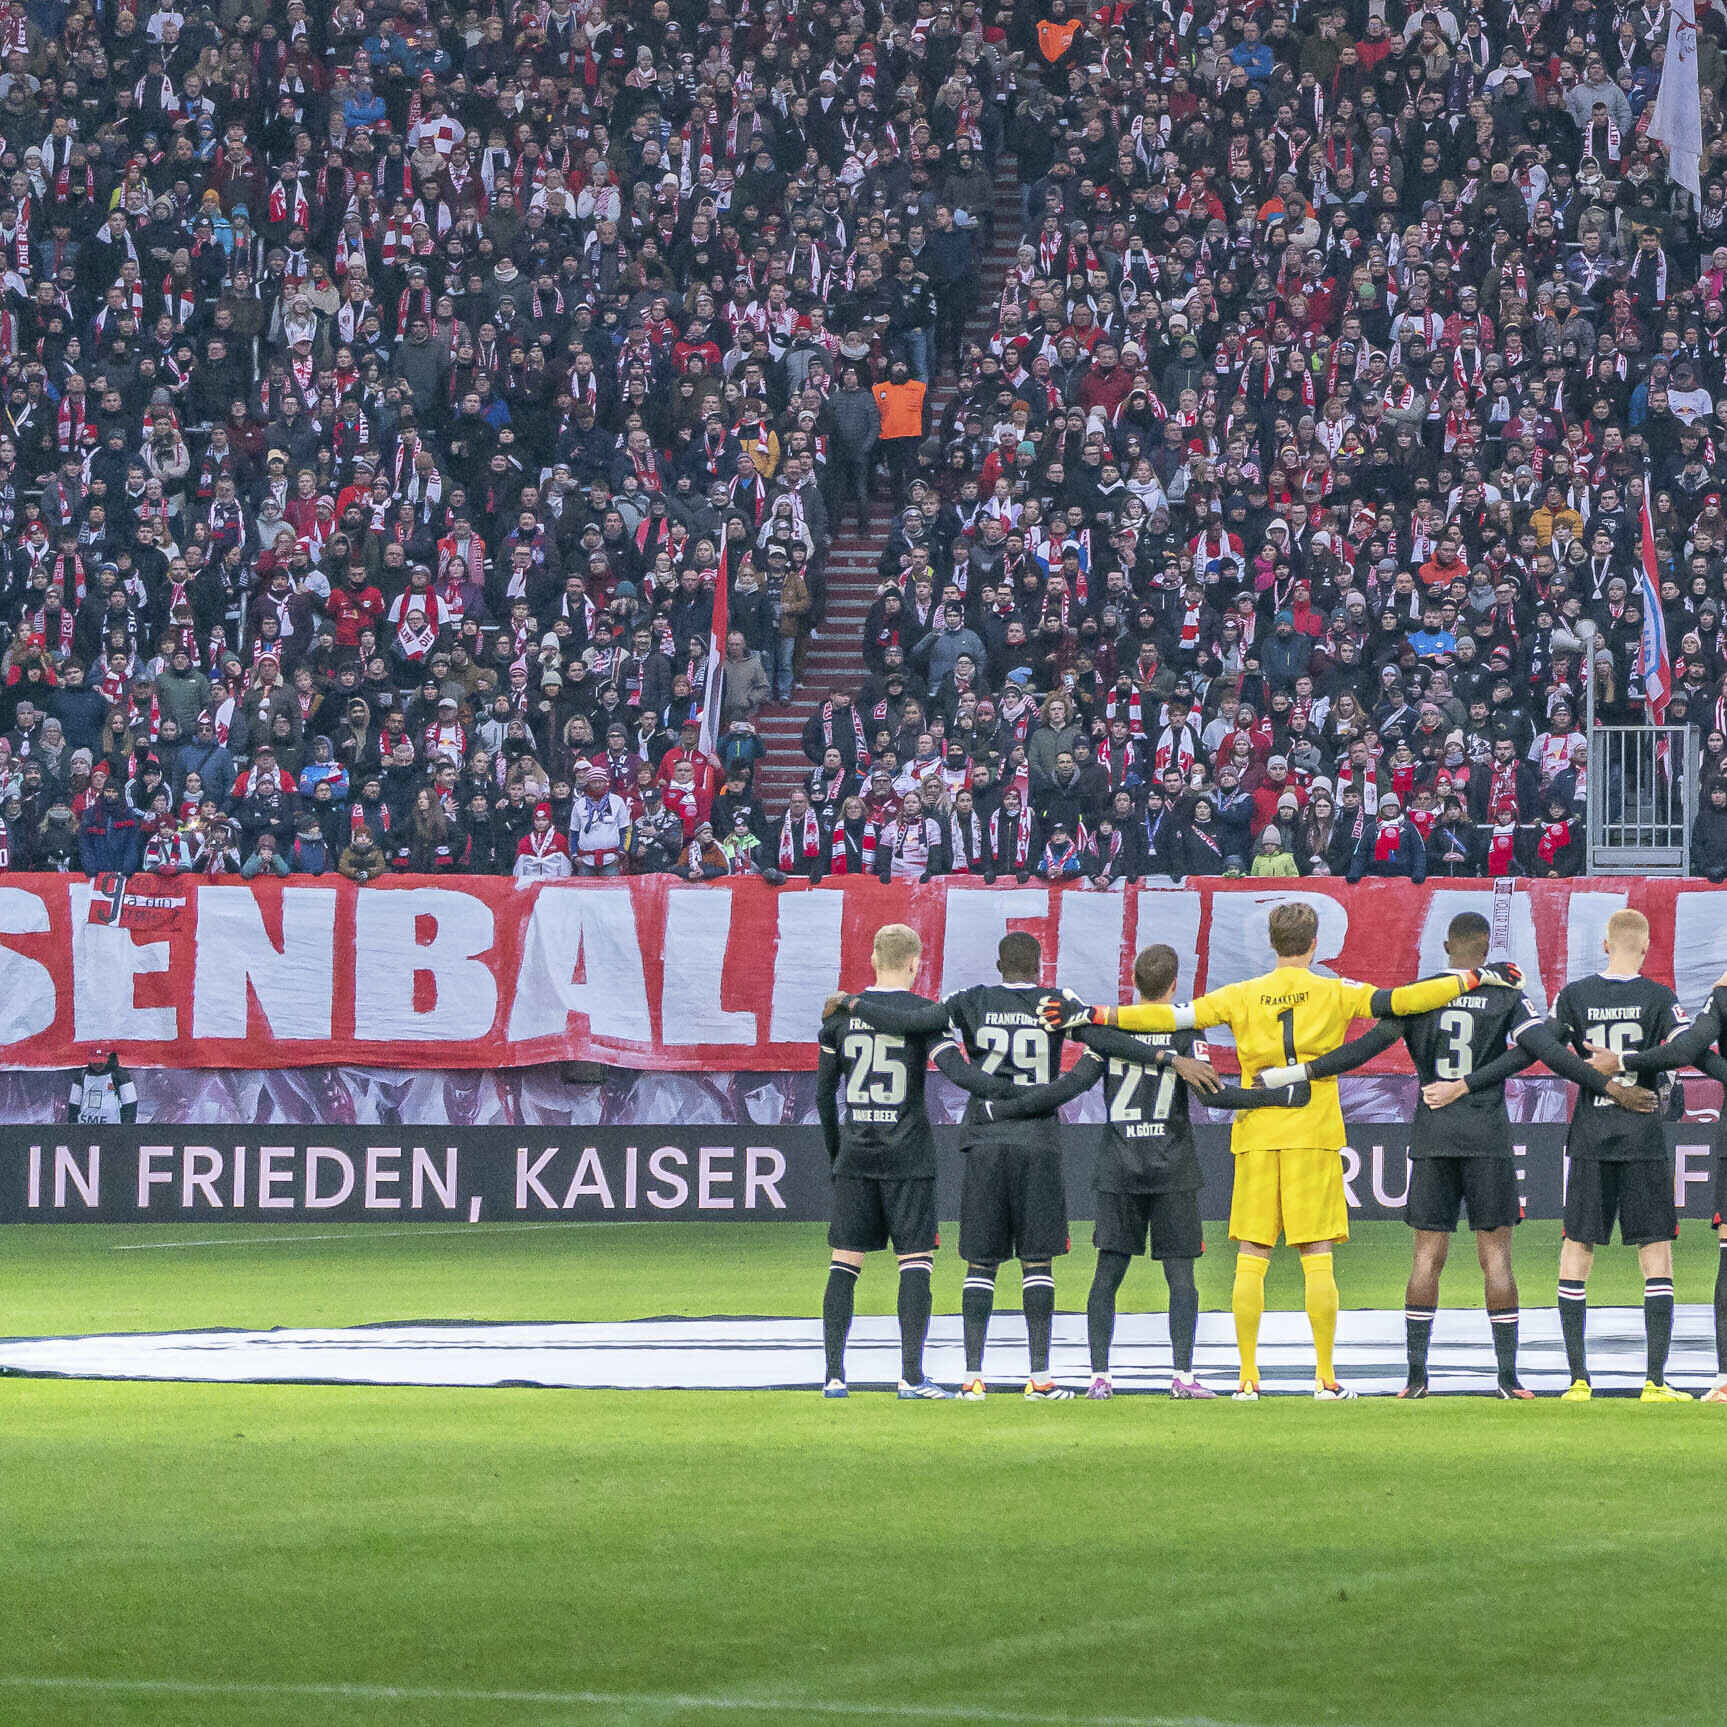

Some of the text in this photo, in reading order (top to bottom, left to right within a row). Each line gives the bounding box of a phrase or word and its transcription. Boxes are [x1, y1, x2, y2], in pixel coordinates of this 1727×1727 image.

[1276, 1007, 1297, 1066] 1
[1436, 1010, 1474, 1080] 3
[1587, 1006, 1641, 1021] FRANKFURT
[843, 1033, 907, 1105] 25
[975, 1026, 1051, 1087] 29
[1108, 1050, 1177, 1123] 27
[1585, 1021, 1645, 1087] 16
[27, 1145, 788, 1224] IN FRIEDEN, KAISER
